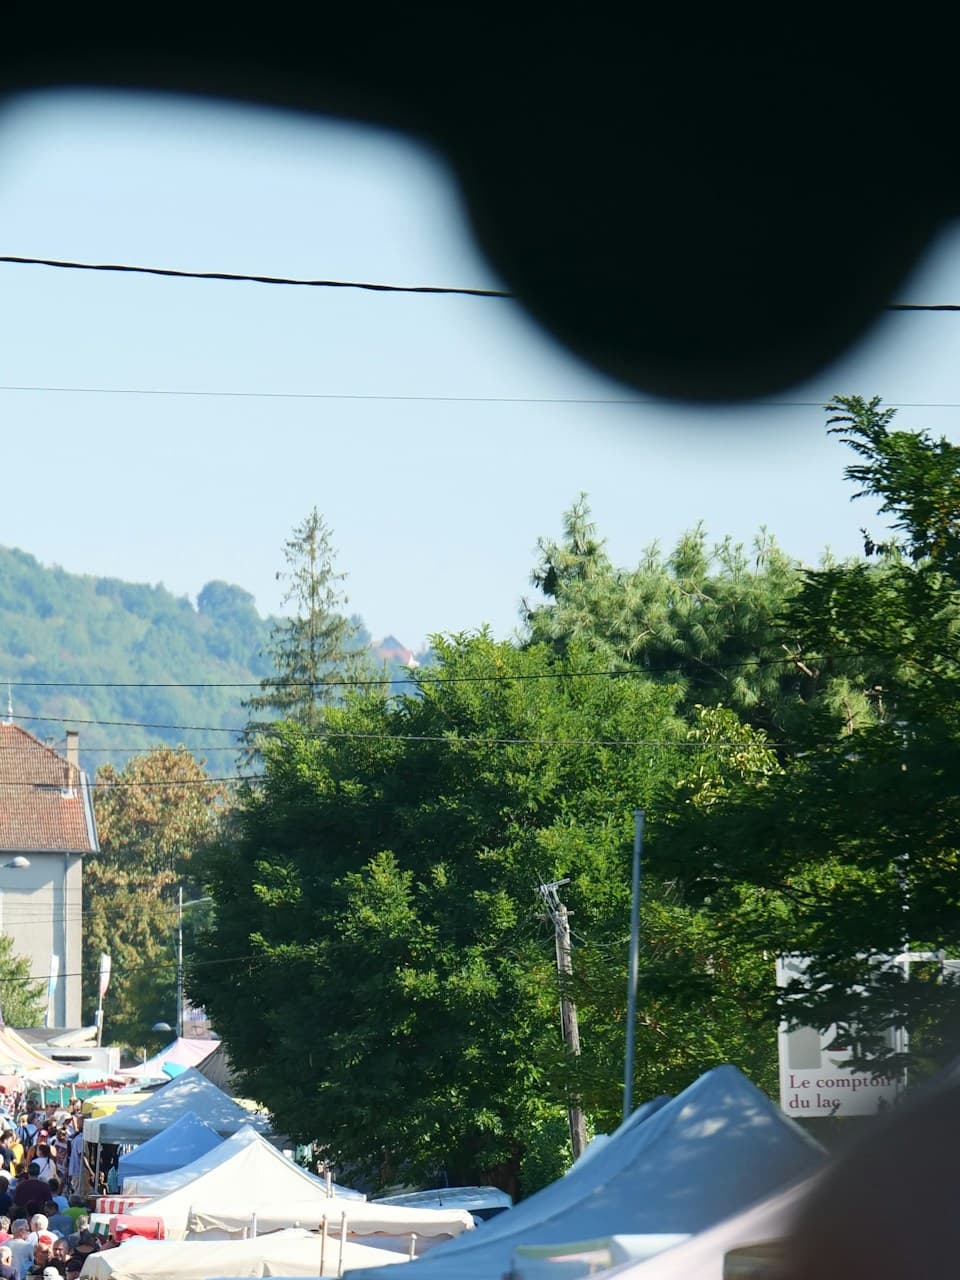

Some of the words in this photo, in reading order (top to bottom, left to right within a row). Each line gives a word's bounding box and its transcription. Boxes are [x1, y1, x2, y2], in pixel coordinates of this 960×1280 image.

[789, 1074, 811, 1089] Le
[789, 1093, 810, 1109] du
[816, 1092, 840, 1108] lac
